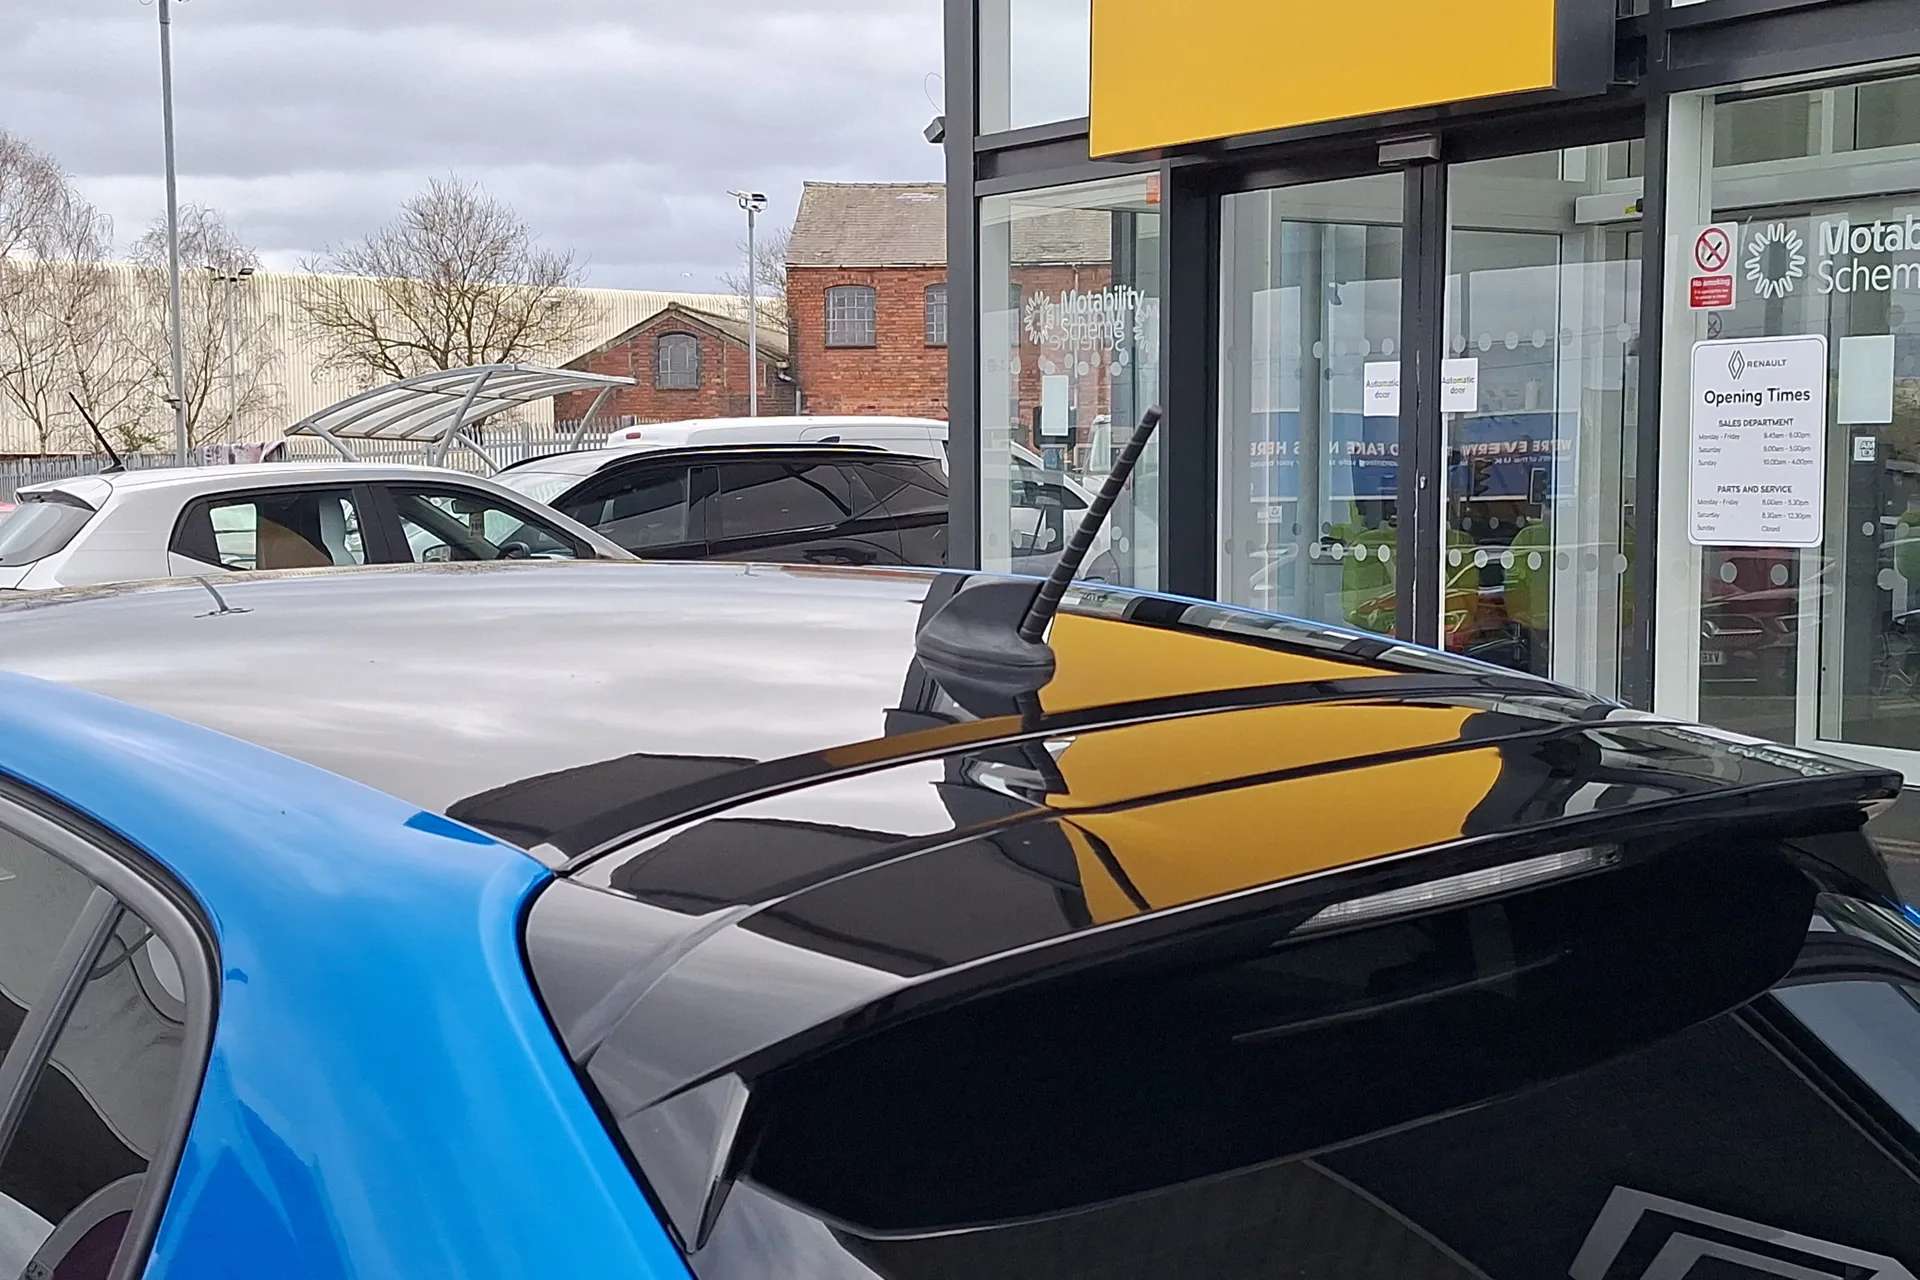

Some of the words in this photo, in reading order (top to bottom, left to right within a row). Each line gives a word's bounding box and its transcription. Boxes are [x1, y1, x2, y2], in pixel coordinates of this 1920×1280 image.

[1060, 284, 1145, 313] Motability
[1061, 318, 1125, 342] Scheme
[1747, 359, 1787, 368] RENAULT
[1704, 389, 1762, 407] Opening
[1767, 388, 1810, 402] Times
[1718, 419, 1741, 428] SALES
[1743, 418, 1794, 427] DEPARTMENT
[1717, 485, 1740, 493] PARTS
[1742, 485, 1759, 493] AND
[1760, 485, 1792, 493] SERVICE
